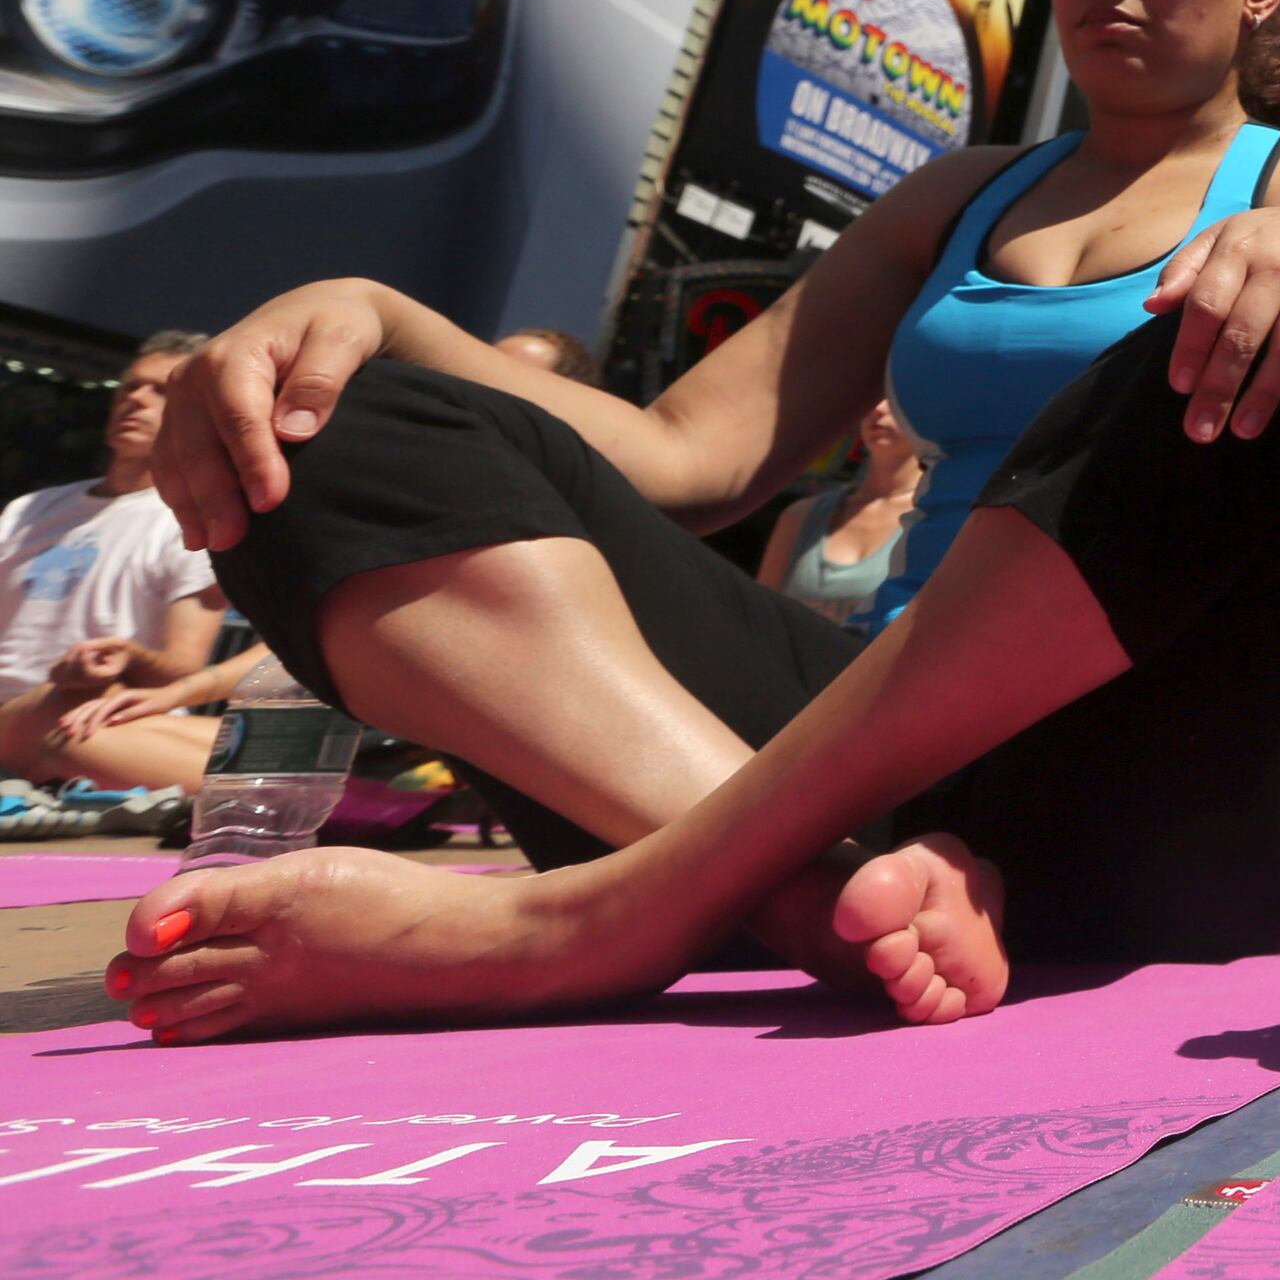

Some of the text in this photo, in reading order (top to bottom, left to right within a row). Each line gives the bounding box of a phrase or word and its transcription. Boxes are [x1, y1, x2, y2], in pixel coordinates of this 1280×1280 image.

[791, 80, 831, 125] ON
[87, 1117, 251, 1134] the
[258, 1115, 362, 1131] to
[362, 1113, 682, 1127] Power
[0, 1138, 758, 1189] ATHL
